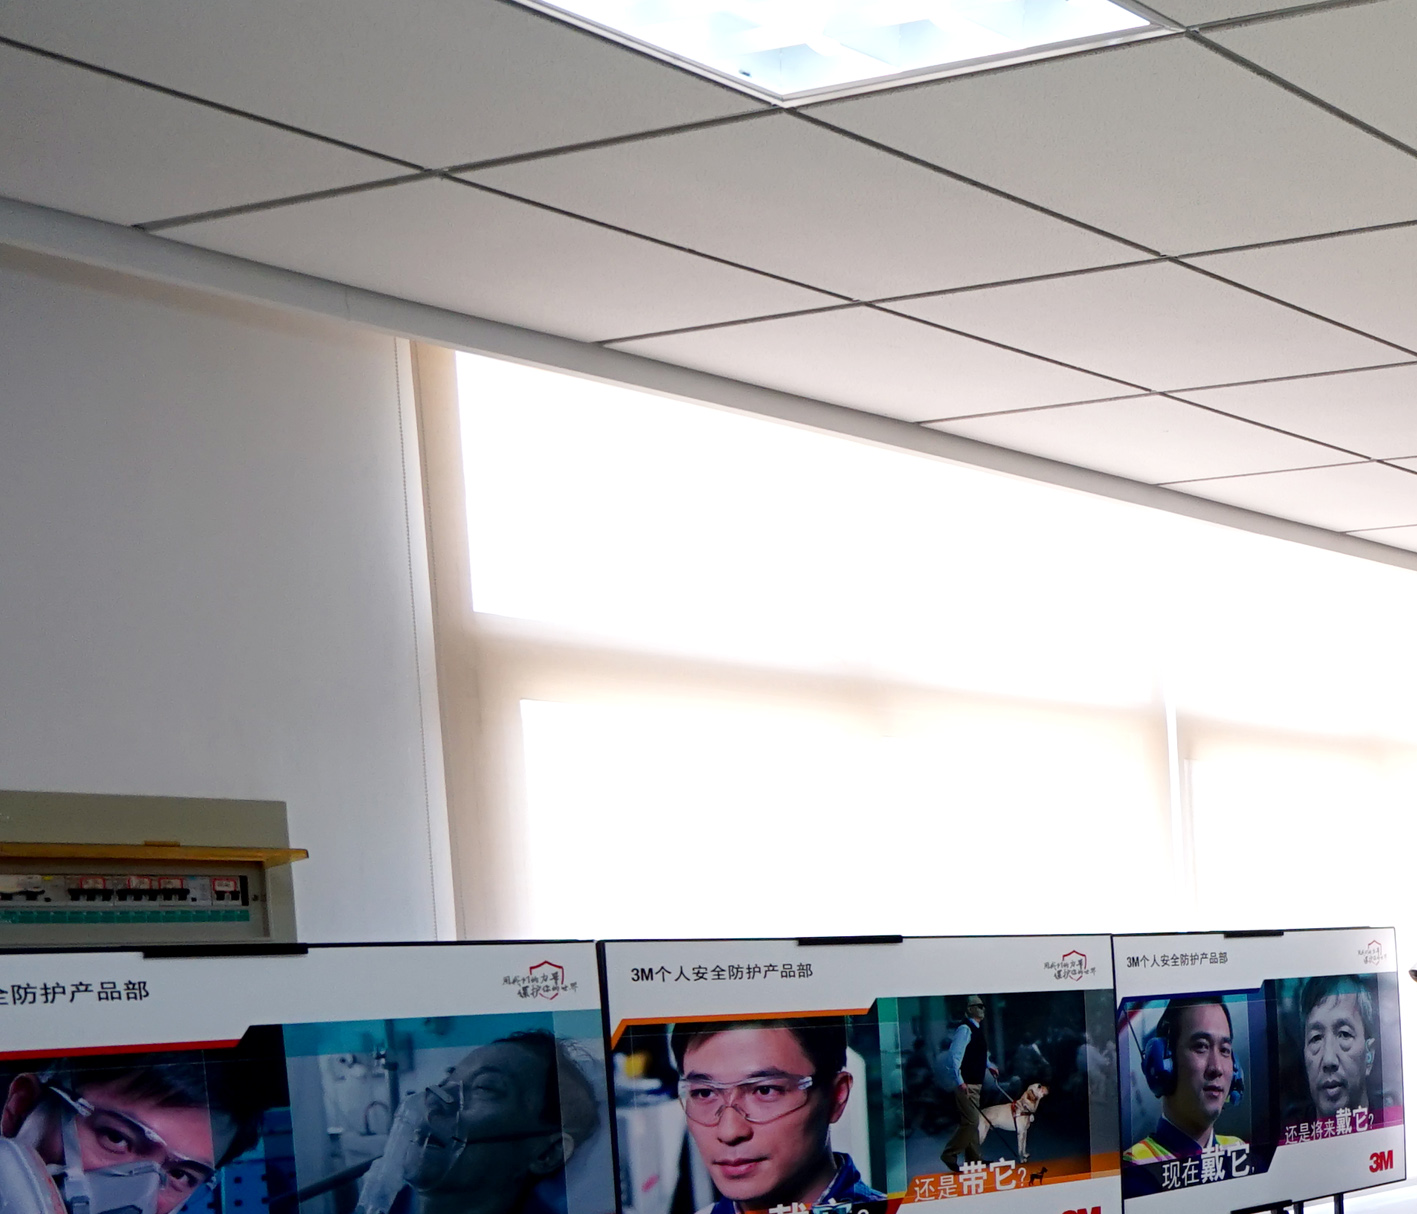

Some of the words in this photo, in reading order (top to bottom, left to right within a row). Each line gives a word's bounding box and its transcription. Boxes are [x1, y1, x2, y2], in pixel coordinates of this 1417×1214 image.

[631, 962, 813, 983] 3M个人安全防护产品部
[1126, 951, 1228, 968] 3M个人安全防护产品部
[1284, 1105, 1375, 1146] 还是将来戴它？
[1161, 1142, 1255, 1190] 现在戴它，
[1368, 1149, 1394, 1174] 3M
[913, 1157, 1027, 1203] 还是带它？
